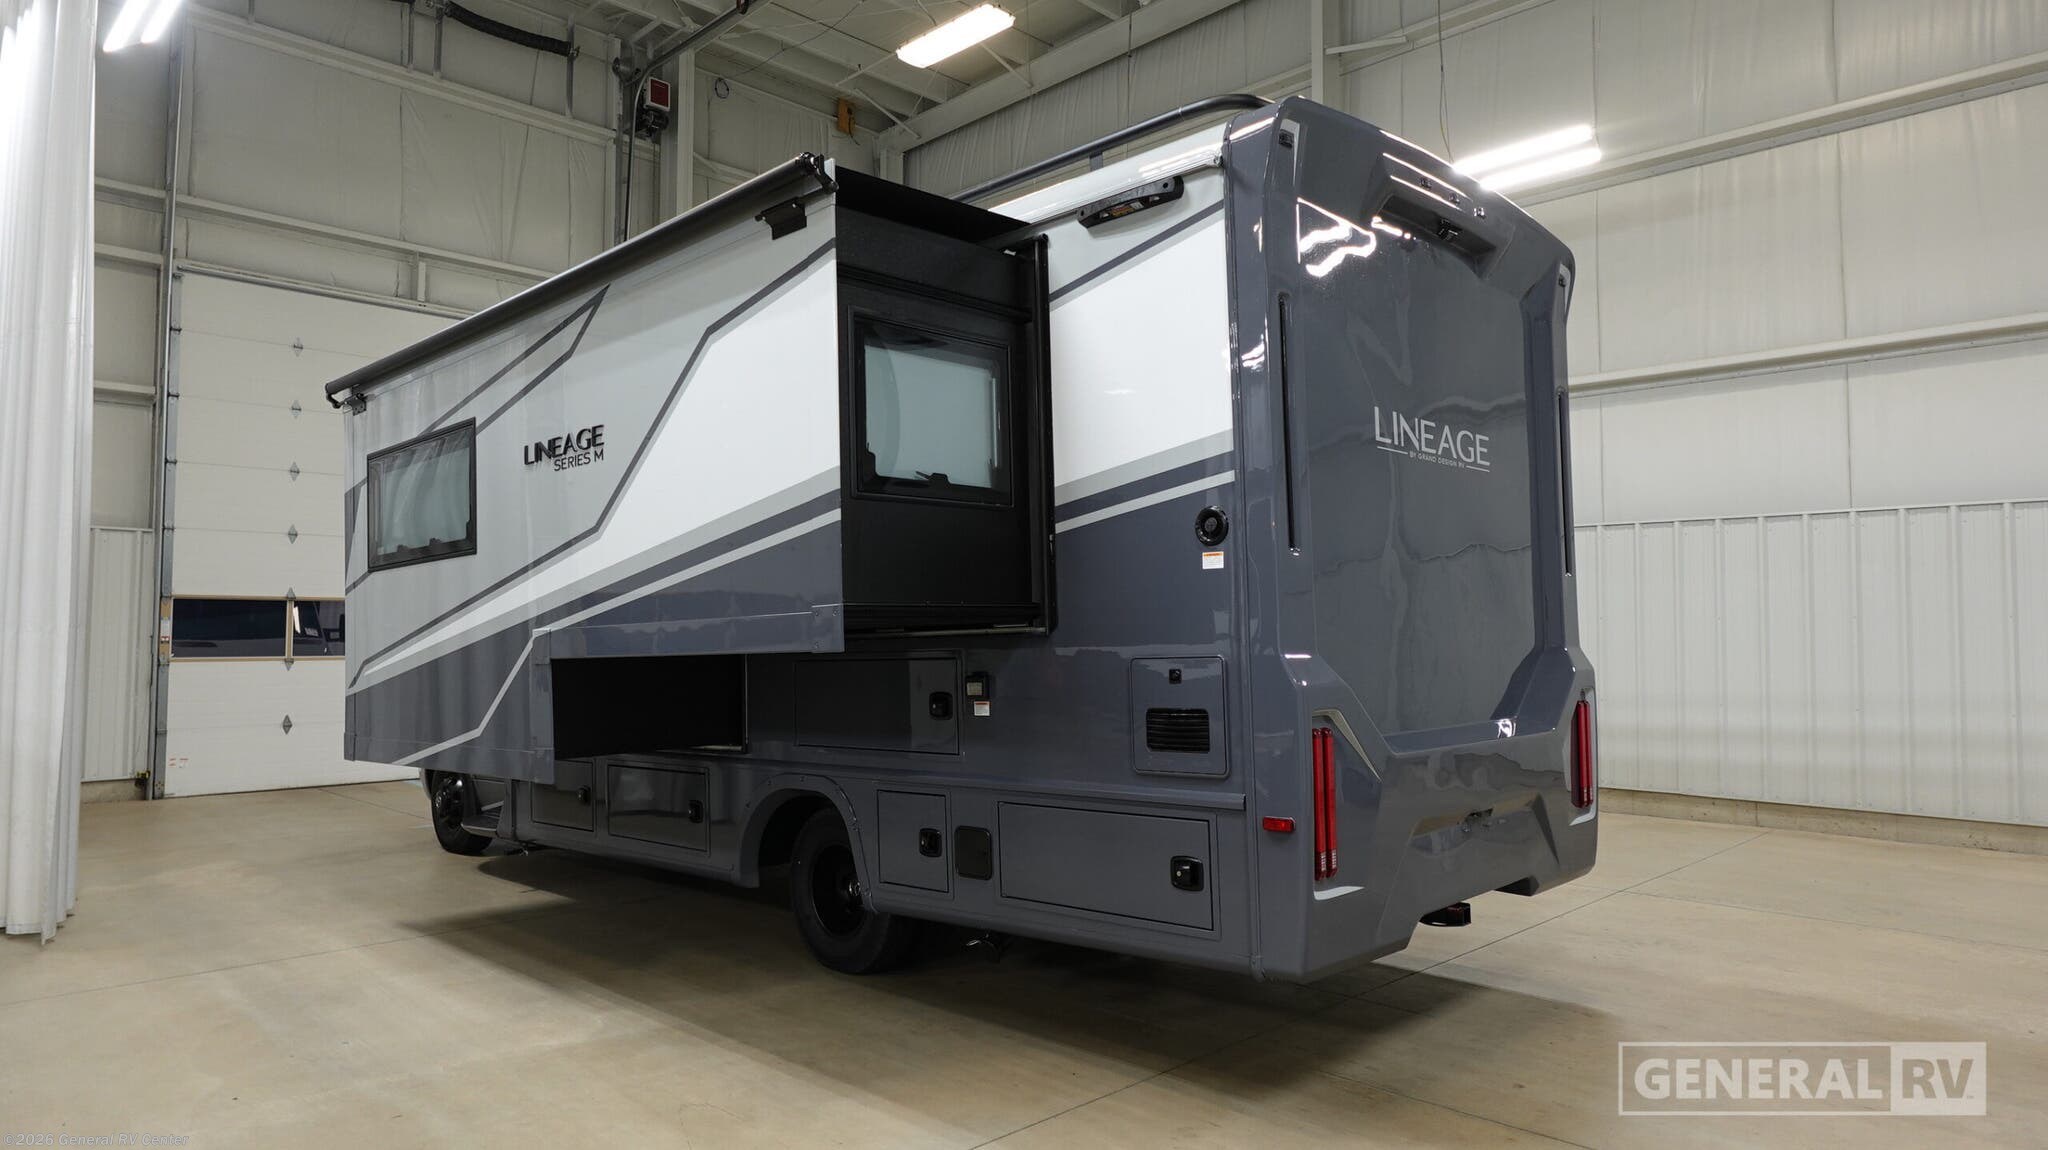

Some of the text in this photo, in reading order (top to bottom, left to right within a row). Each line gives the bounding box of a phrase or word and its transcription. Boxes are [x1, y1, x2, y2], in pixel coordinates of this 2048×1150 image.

[524, 424, 605, 466] LINEAGE
[1374, 406, 1491, 466] LINEAGE
[554, 448, 604, 472] SERIES M
